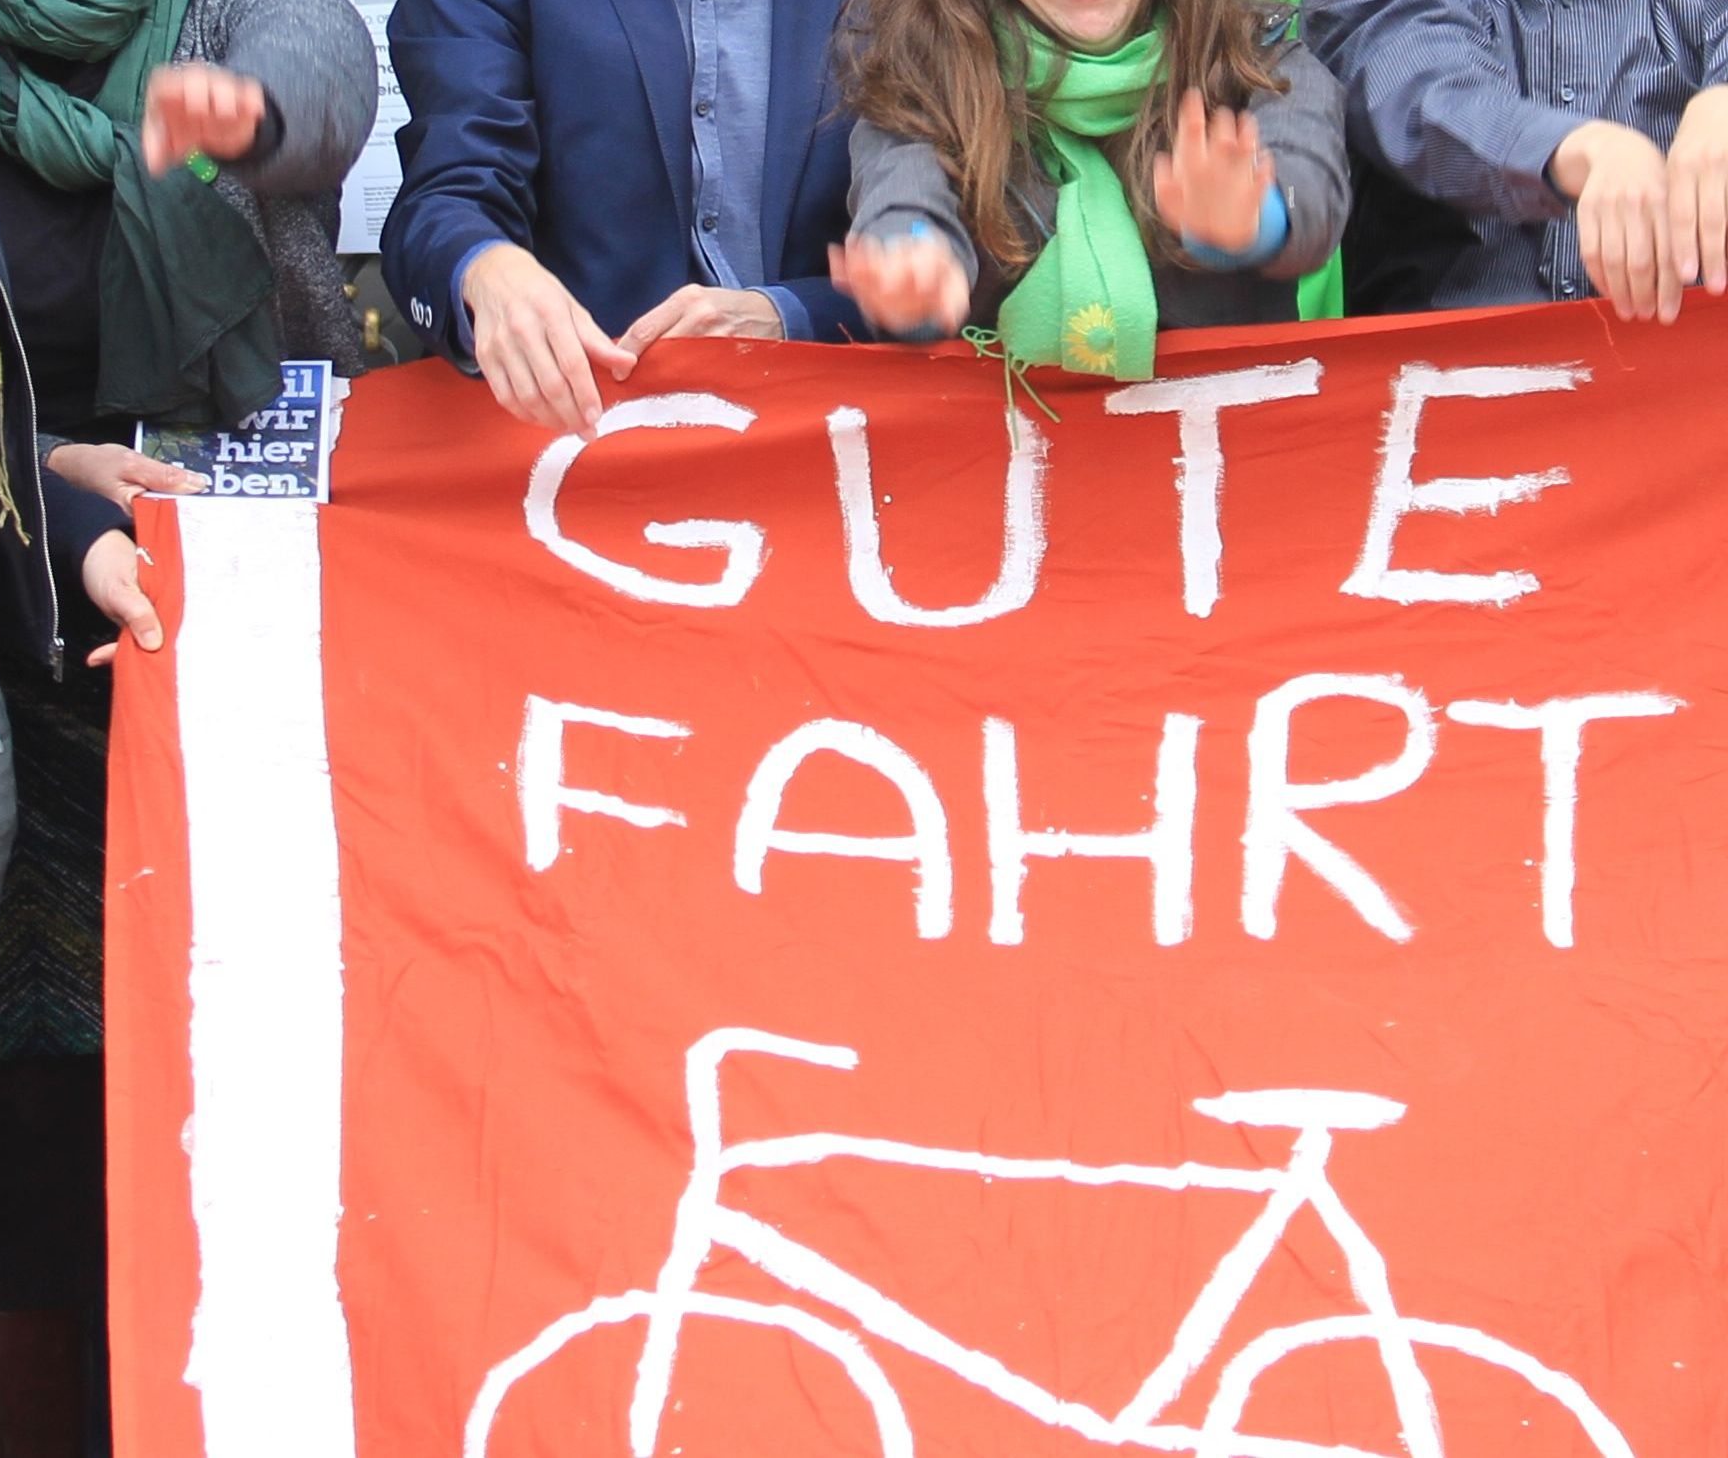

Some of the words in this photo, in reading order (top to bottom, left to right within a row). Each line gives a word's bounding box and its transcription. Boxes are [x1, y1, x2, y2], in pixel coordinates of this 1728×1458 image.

[216, 432, 315, 463] hier
[282, 369, 316, 398] il
[524, 359, 1592, 627] GUTE
[516, 672, 1688, 949] FAHRT
